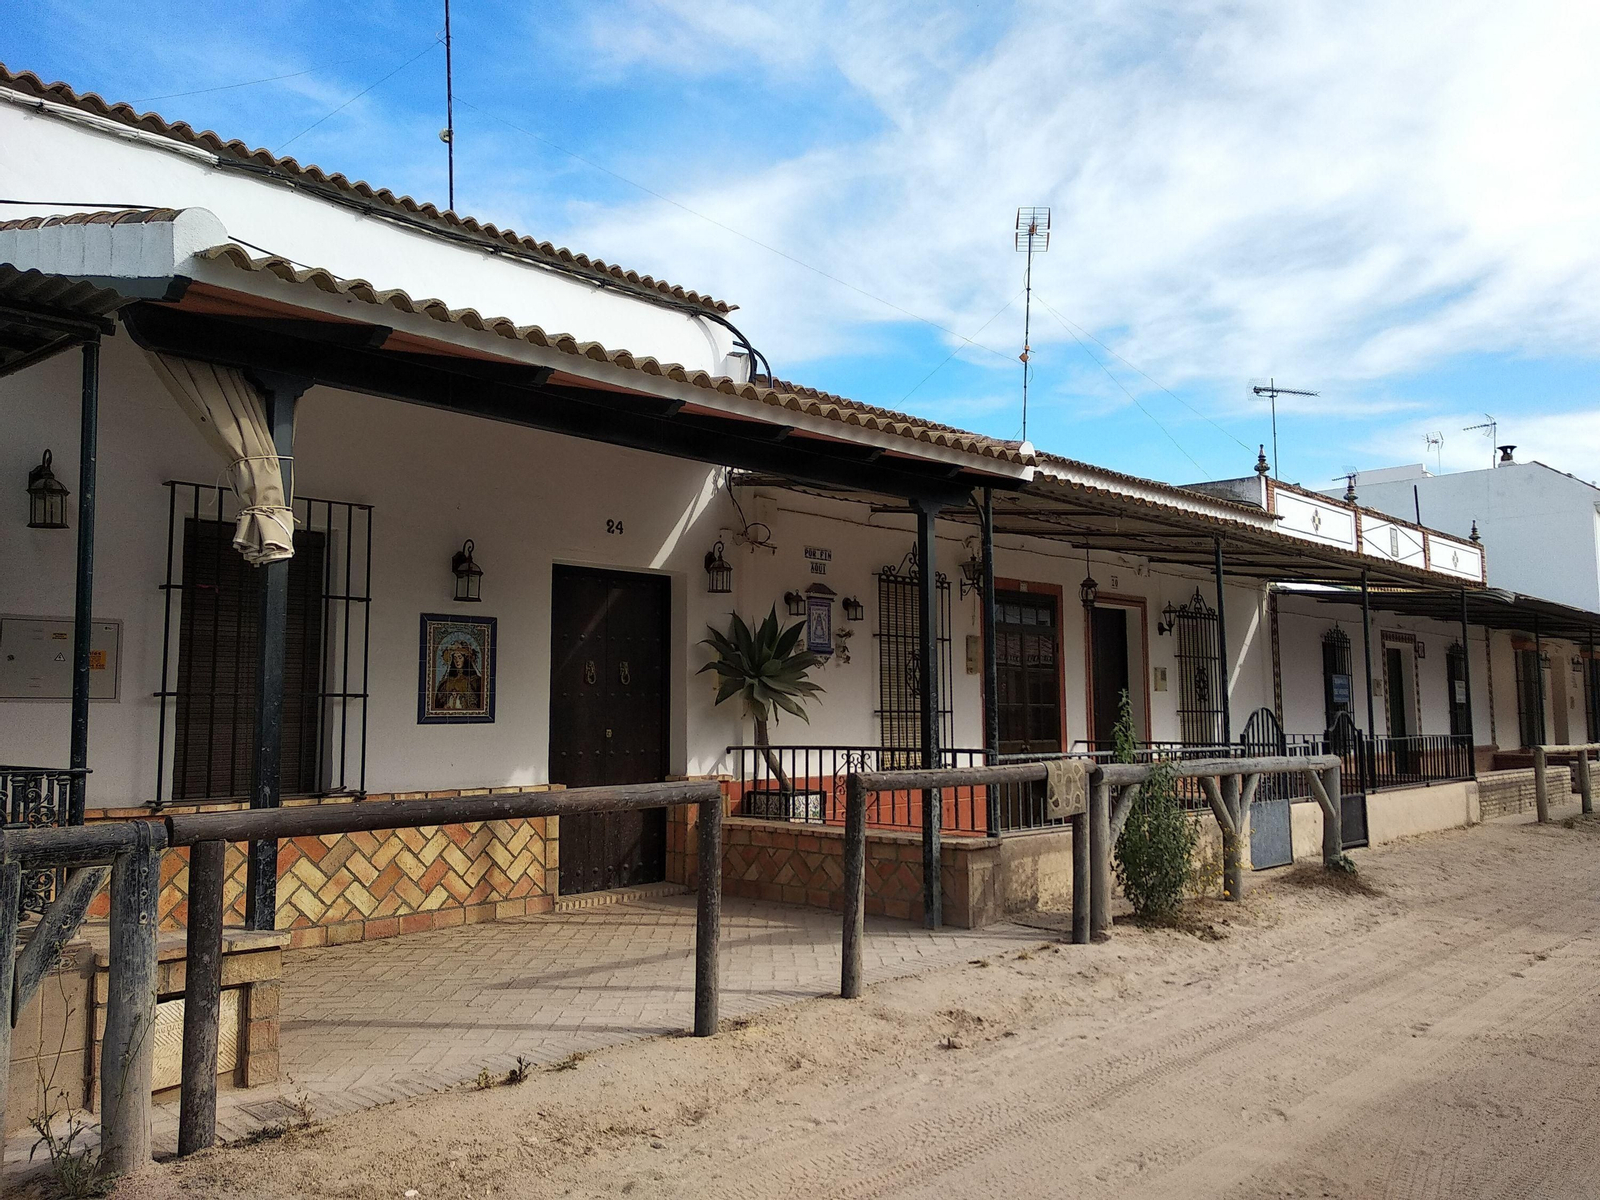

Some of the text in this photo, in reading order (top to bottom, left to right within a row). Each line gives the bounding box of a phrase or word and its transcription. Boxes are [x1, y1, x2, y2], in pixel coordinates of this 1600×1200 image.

[606, 518, 624, 535] 24
[804, 547, 832, 560] POR FIN
